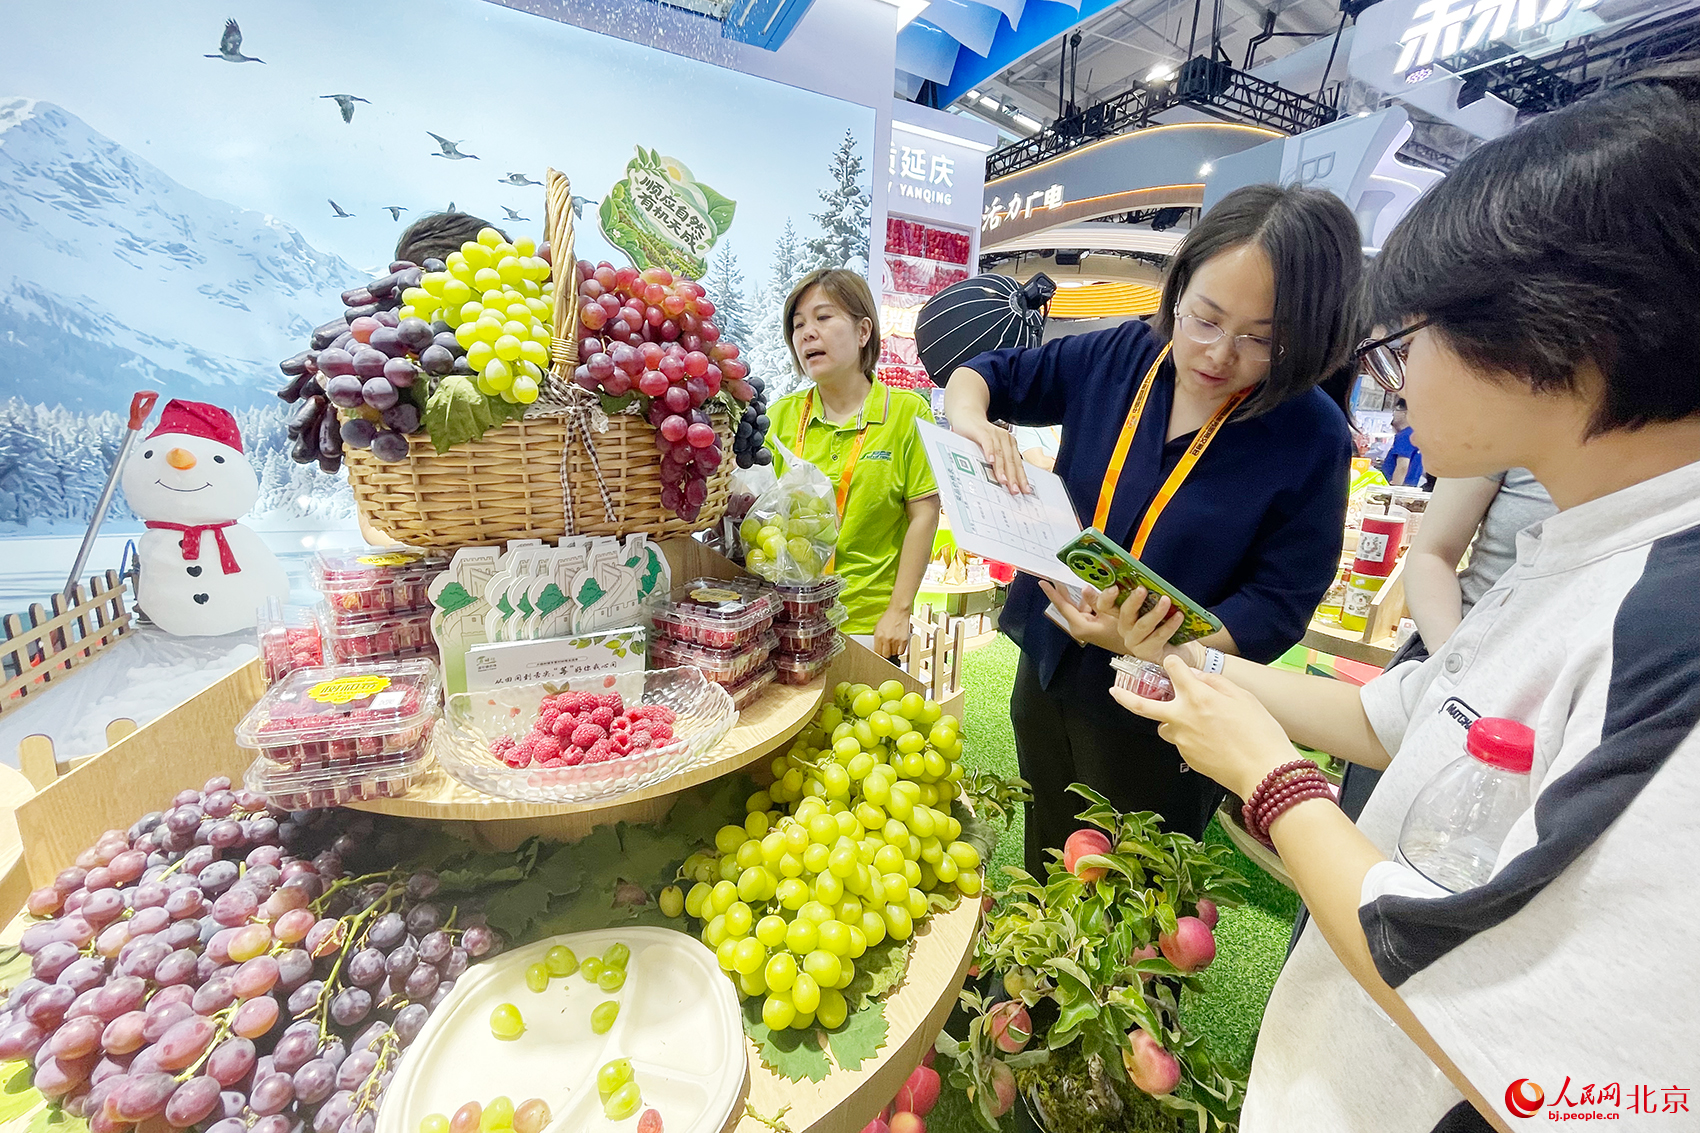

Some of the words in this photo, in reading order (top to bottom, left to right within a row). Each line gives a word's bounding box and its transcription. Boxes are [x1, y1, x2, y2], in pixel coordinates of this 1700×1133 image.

[638, 191, 699, 254] 有机天成
[640, 176, 708, 240] 顺应自然
[900, 183, 952, 206] YANQING
